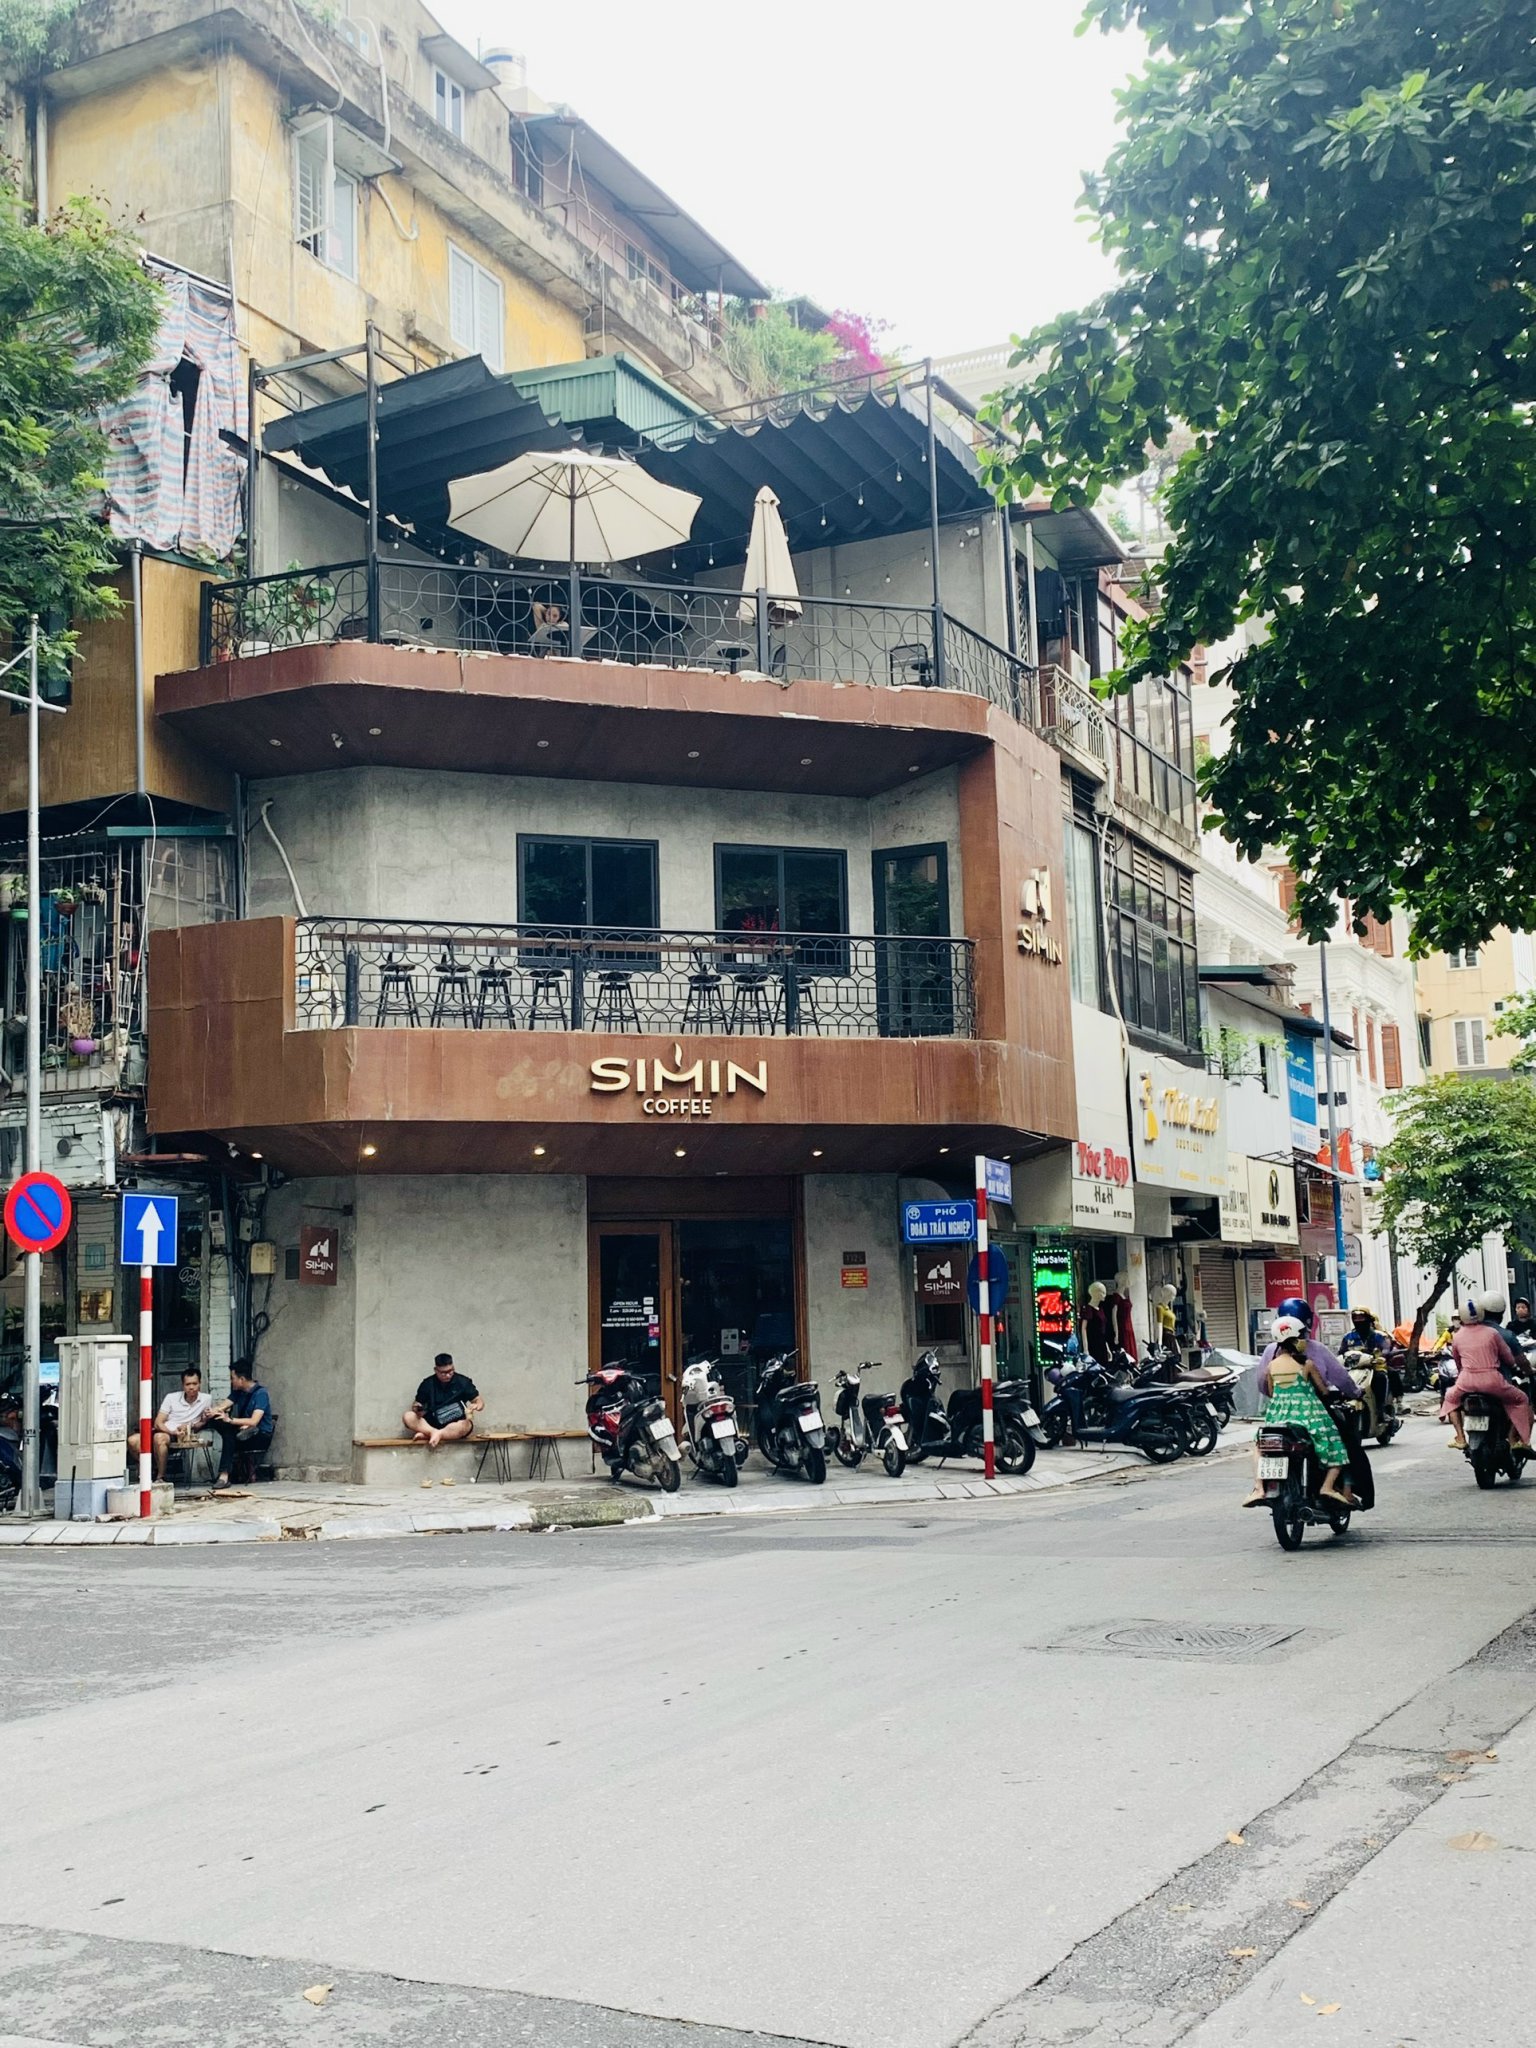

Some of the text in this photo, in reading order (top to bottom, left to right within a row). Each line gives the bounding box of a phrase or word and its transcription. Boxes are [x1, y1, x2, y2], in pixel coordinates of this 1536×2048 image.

[1018, 923, 1062, 965] SIMIN
[590, 1056, 768, 1096] SIMIN
[643, 1098, 713, 1115] COFFEE
[935, 1205, 957, 1216] PHỐ
[929, 1218, 947, 1236] TRẦN
[948, 1219, 971, 1237] NGHIỆP
[305, 1258, 334, 1271] SIMIN
[924, 1281, 960, 1291] SIMIN
[1268, 1278, 1300, 1286] viettel
